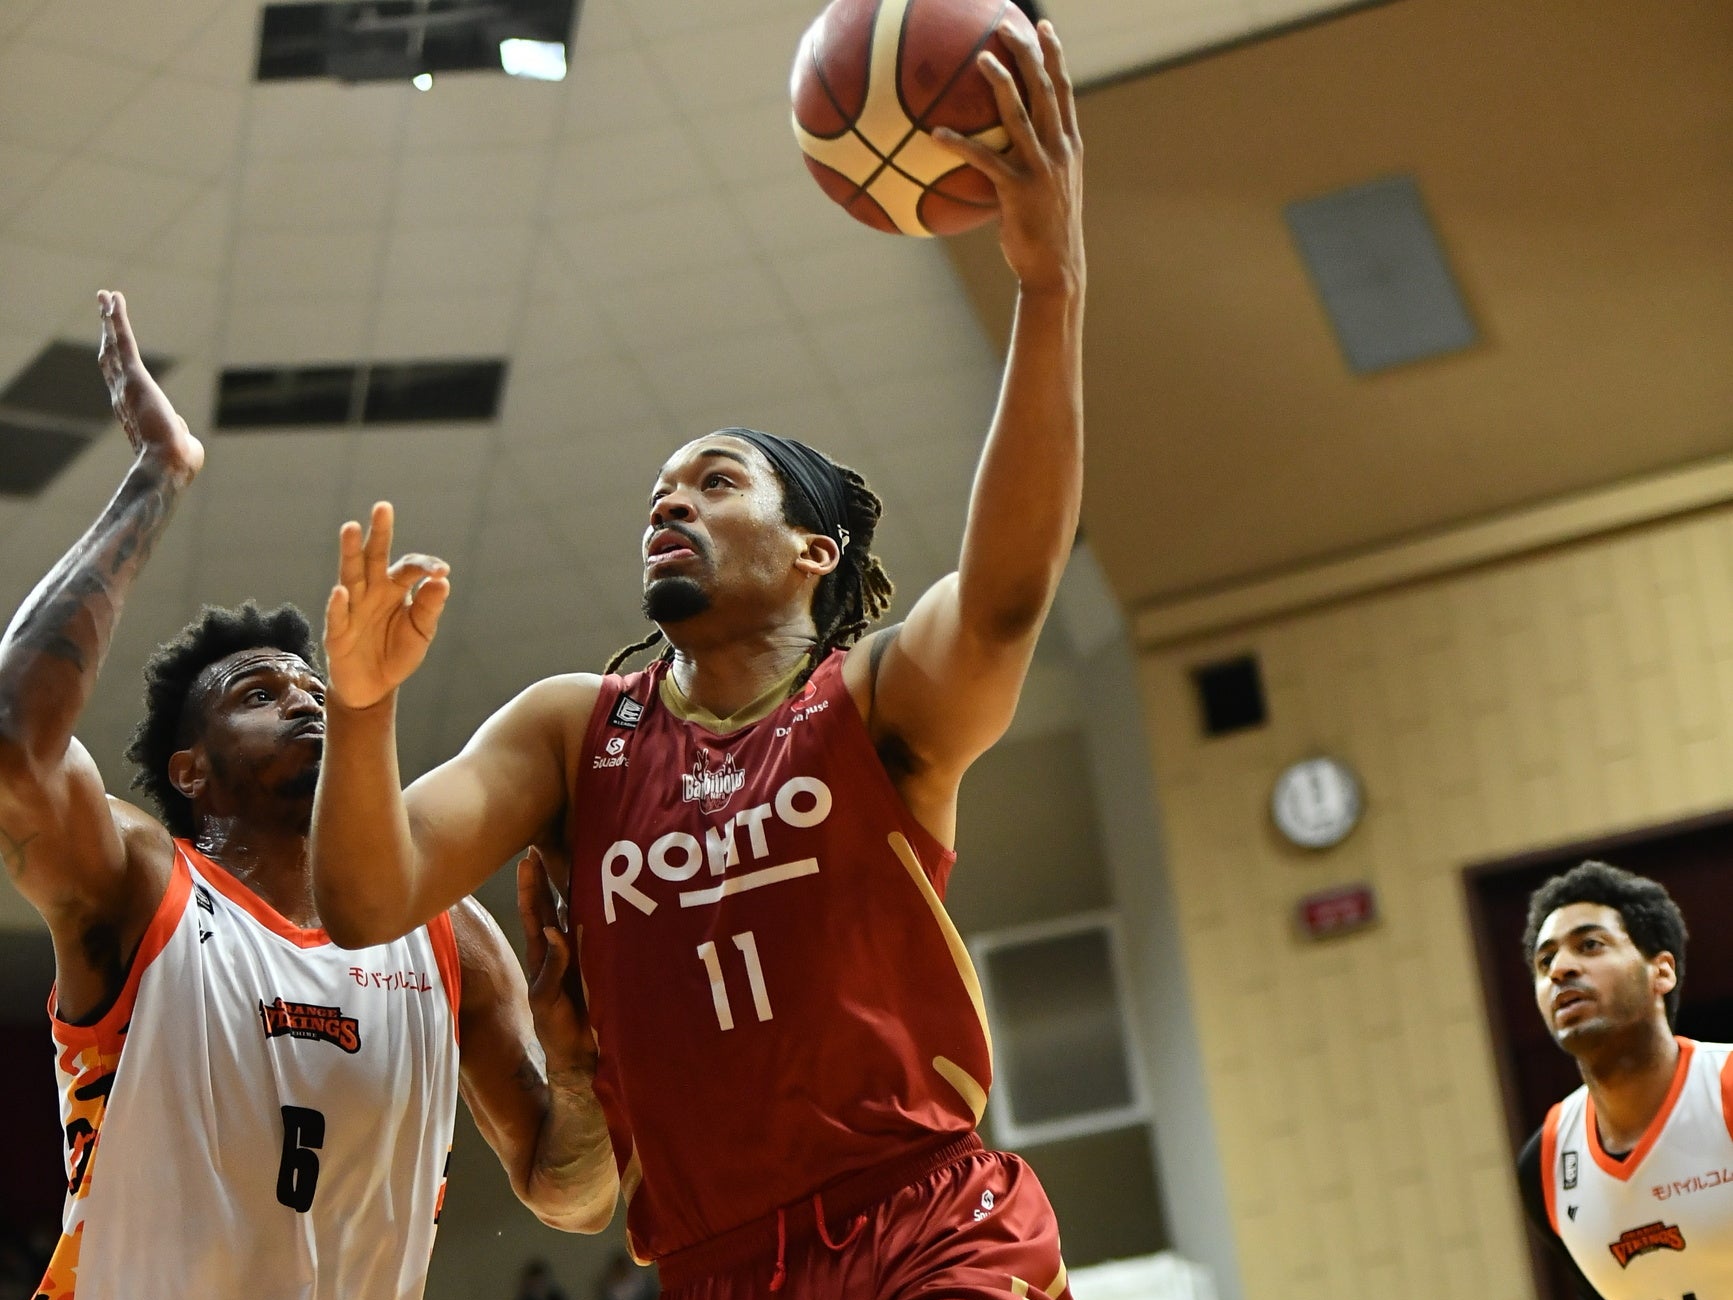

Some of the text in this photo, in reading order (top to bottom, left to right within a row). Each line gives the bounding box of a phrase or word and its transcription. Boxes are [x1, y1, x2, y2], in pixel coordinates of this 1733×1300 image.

[601, 776, 833, 925] ROHTO
[348, 966, 433, 993] モバイルコム
[697, 930, 774, 1031] 11
[276, 1105, 326, 1213] 6
